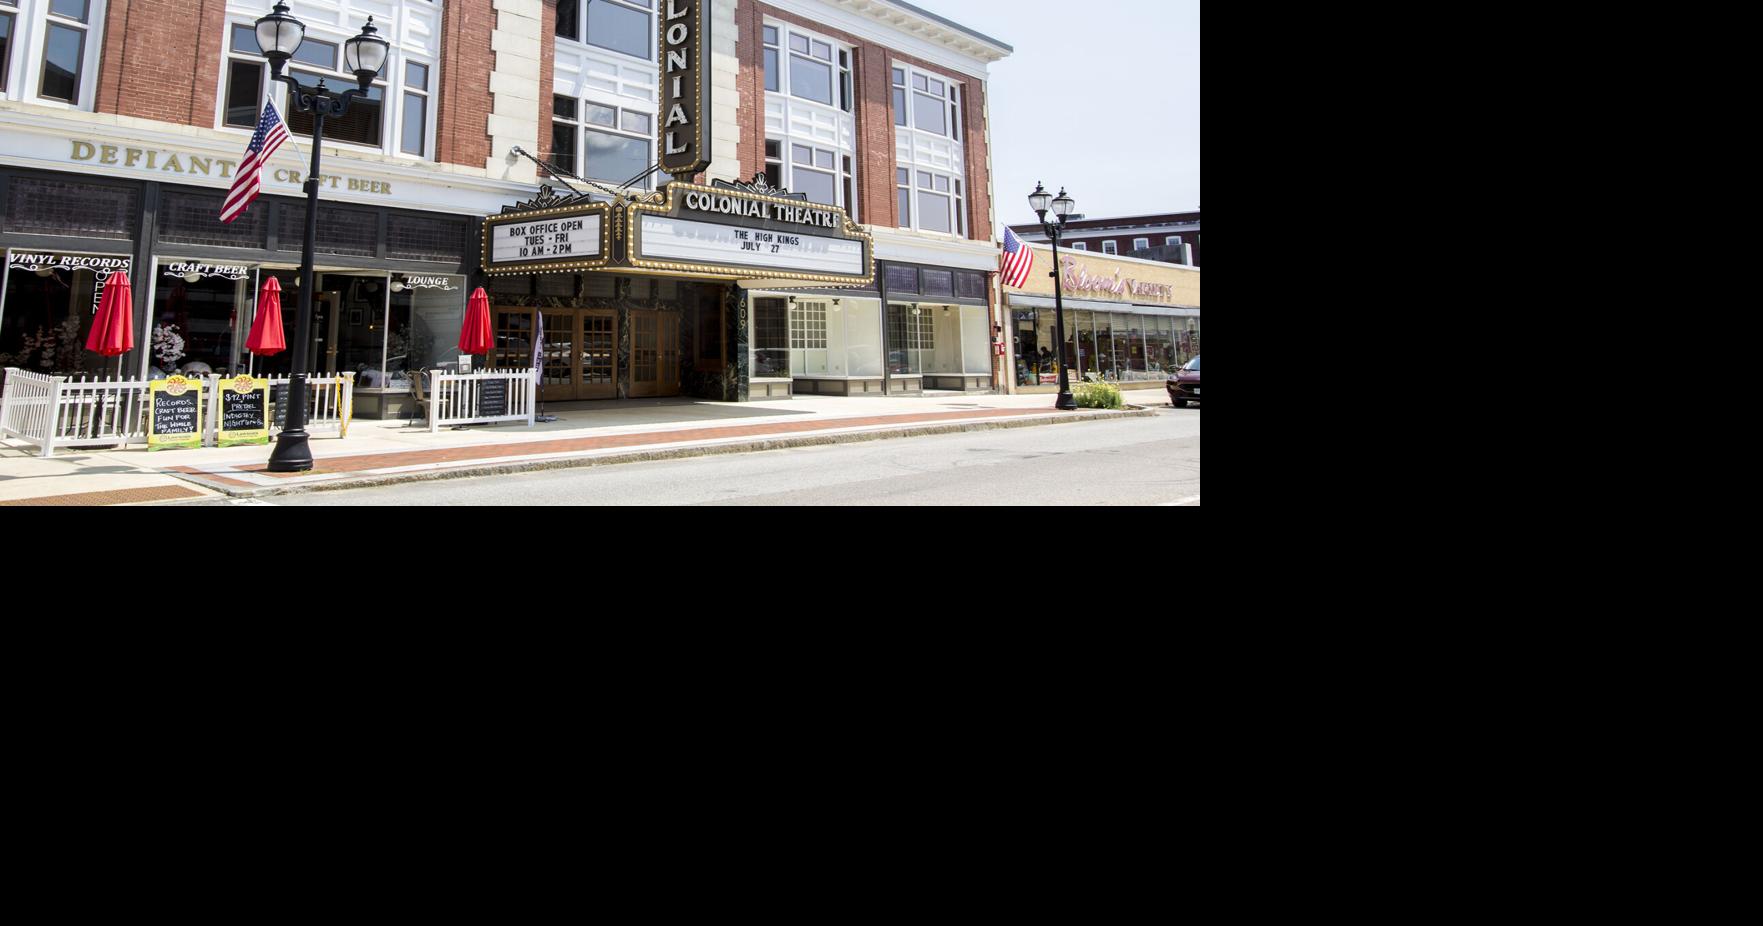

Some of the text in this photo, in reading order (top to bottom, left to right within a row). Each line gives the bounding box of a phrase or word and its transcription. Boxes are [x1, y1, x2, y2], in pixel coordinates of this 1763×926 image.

[70, 140, 237, 178] DEFIANT
[274, 168, 393, 195] CRFT BEER
[686, 191, 840, 228] COLONIAL THEATRE
[509, 220, 583, 237] BOX OFFICE OPEN
[525, 235, 545, 246] TUES
[555, 233, 569, 243] FRI
[734, 229, 800, 246] THE HIGH KINGS
[519, 247, 528, 257] 10
[531, 245, 544, 256] AM
[740, 241, 780, 254] JULY 27
[10, 253, 130, 268] VINYL RECORDS
[169, 262, 248, 275] CRAFT BEER
[407, 275, 449, 286] LOUNGE
[242, 393, 261, 401] PINT
[154, 407, 176, 415] CRAFT
[157, 414, 174, 422] FUN
